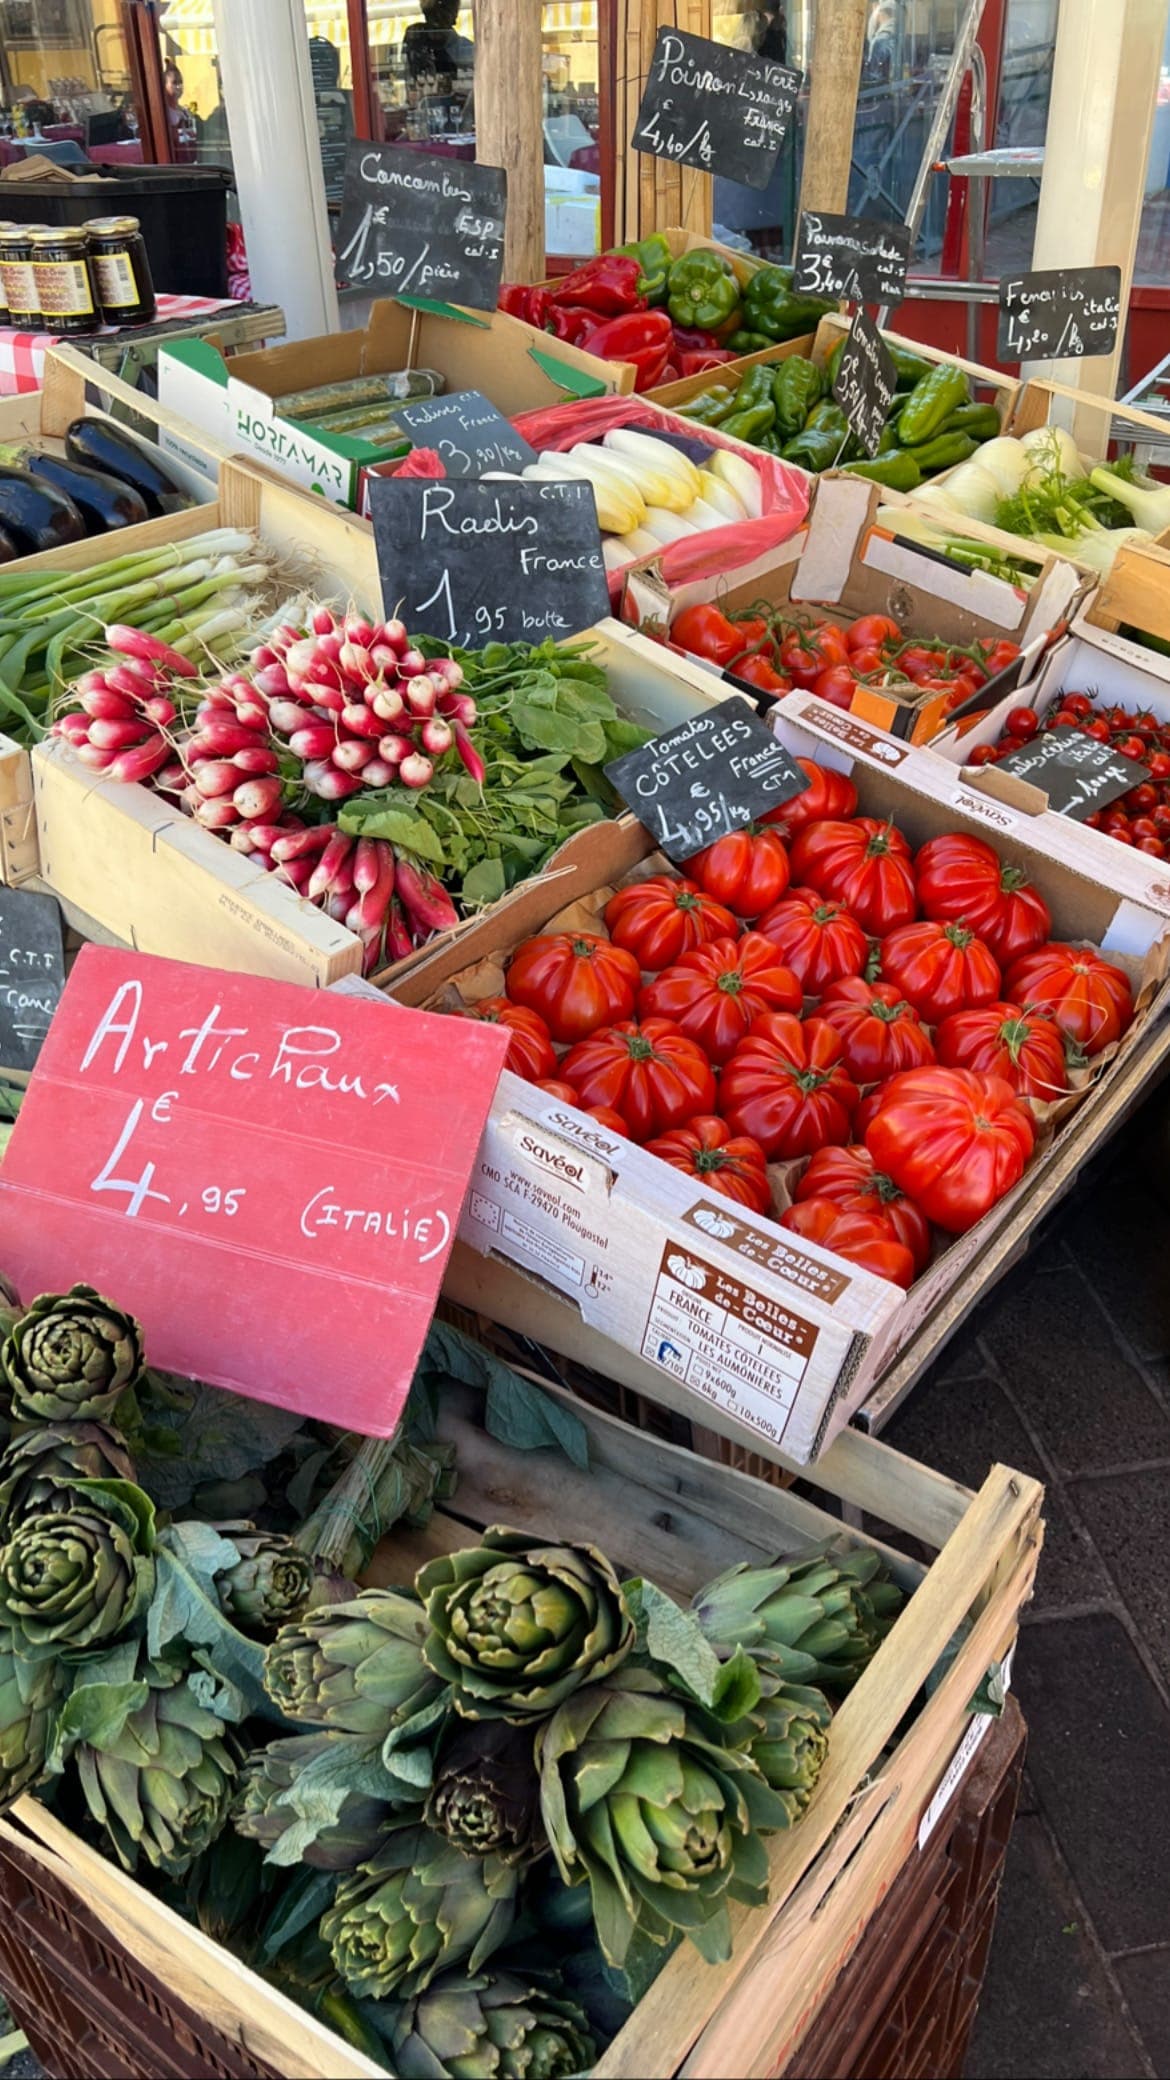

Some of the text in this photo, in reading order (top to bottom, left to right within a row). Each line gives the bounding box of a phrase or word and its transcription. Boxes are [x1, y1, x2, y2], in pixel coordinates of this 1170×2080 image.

[742, 107, 786, 136] France
[458, 413, 500, 431] France
[237, 409, 342, 489] HORTAMAR
[421, 486, 539, 540] Radis
[520, 547, 604, 575] France
[643, 719, 715, 758] Tomates
[729, 741, 784, 778] France
[690, 782, 710, 799] €
[80, 980, 401, 1105] Artichaux
[152, 1090, 179, 1122] €
[548, 1112, 621, 1156] Savéol
[520, 1135, 587, 1183] Savéol
[504, 1177, 521, 1195] SCA
[562, 1213, 609, 1249] Plougastel
[744, 1230, 770, 1250] Les
[771, 1246, 829, 1280] Belles
[669, 1290, 713, 1325] FRANCE
[714, 1293, 732, 1308] de
[716, 1276, 740, 1297] Les
[743, 1289, 798, 1333] Belles
[687, 1319, 732, 1354] TOMATES
[698, 1341, 716, 1358] LES
[705, 1369, 737, 1399] 9x600g
[701, 1382, 778, 1438] 6kg 10x500g
